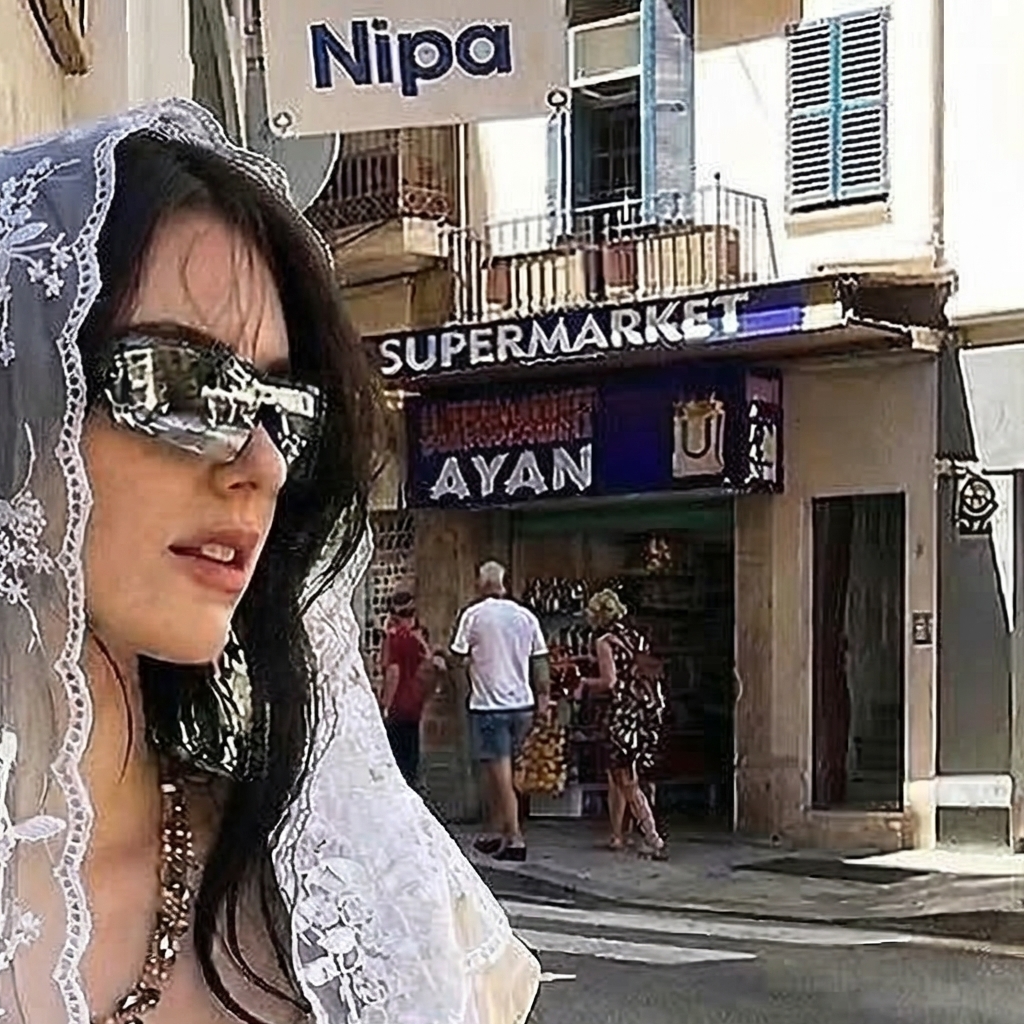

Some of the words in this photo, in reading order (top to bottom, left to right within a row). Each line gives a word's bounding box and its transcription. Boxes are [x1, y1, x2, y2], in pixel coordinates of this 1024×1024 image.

[309, 18, 513, 97] Nipa
[378, 294, 748, 376] SUPERMARKET
[430, 443, 592, 500] AYAN
